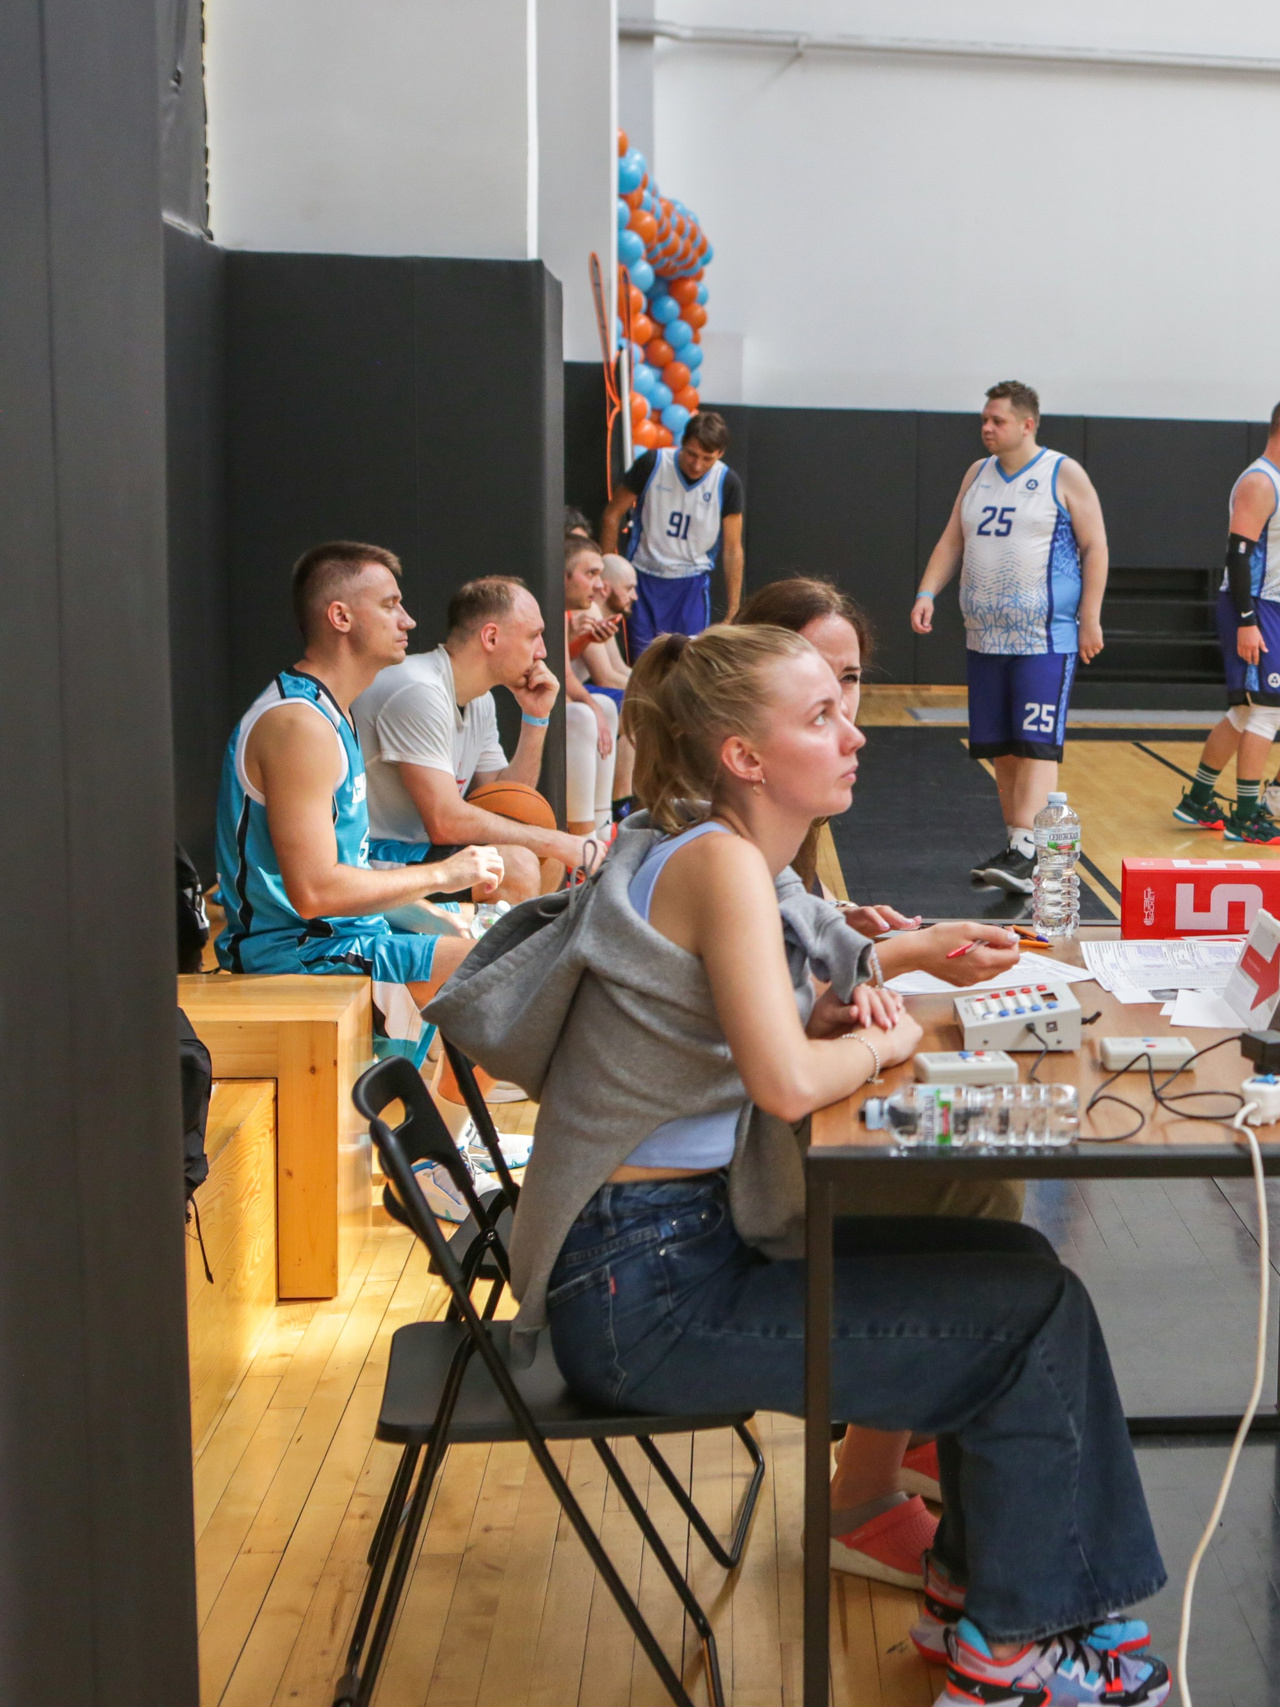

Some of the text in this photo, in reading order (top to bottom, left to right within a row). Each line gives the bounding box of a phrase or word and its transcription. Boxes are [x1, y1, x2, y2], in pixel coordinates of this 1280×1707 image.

[666, 511, 691, 540] 91
[976, 505, 1017, 537] 25
[1022, 702, 1057, 734] 25
[1174, 883, 1264, 931] 5
